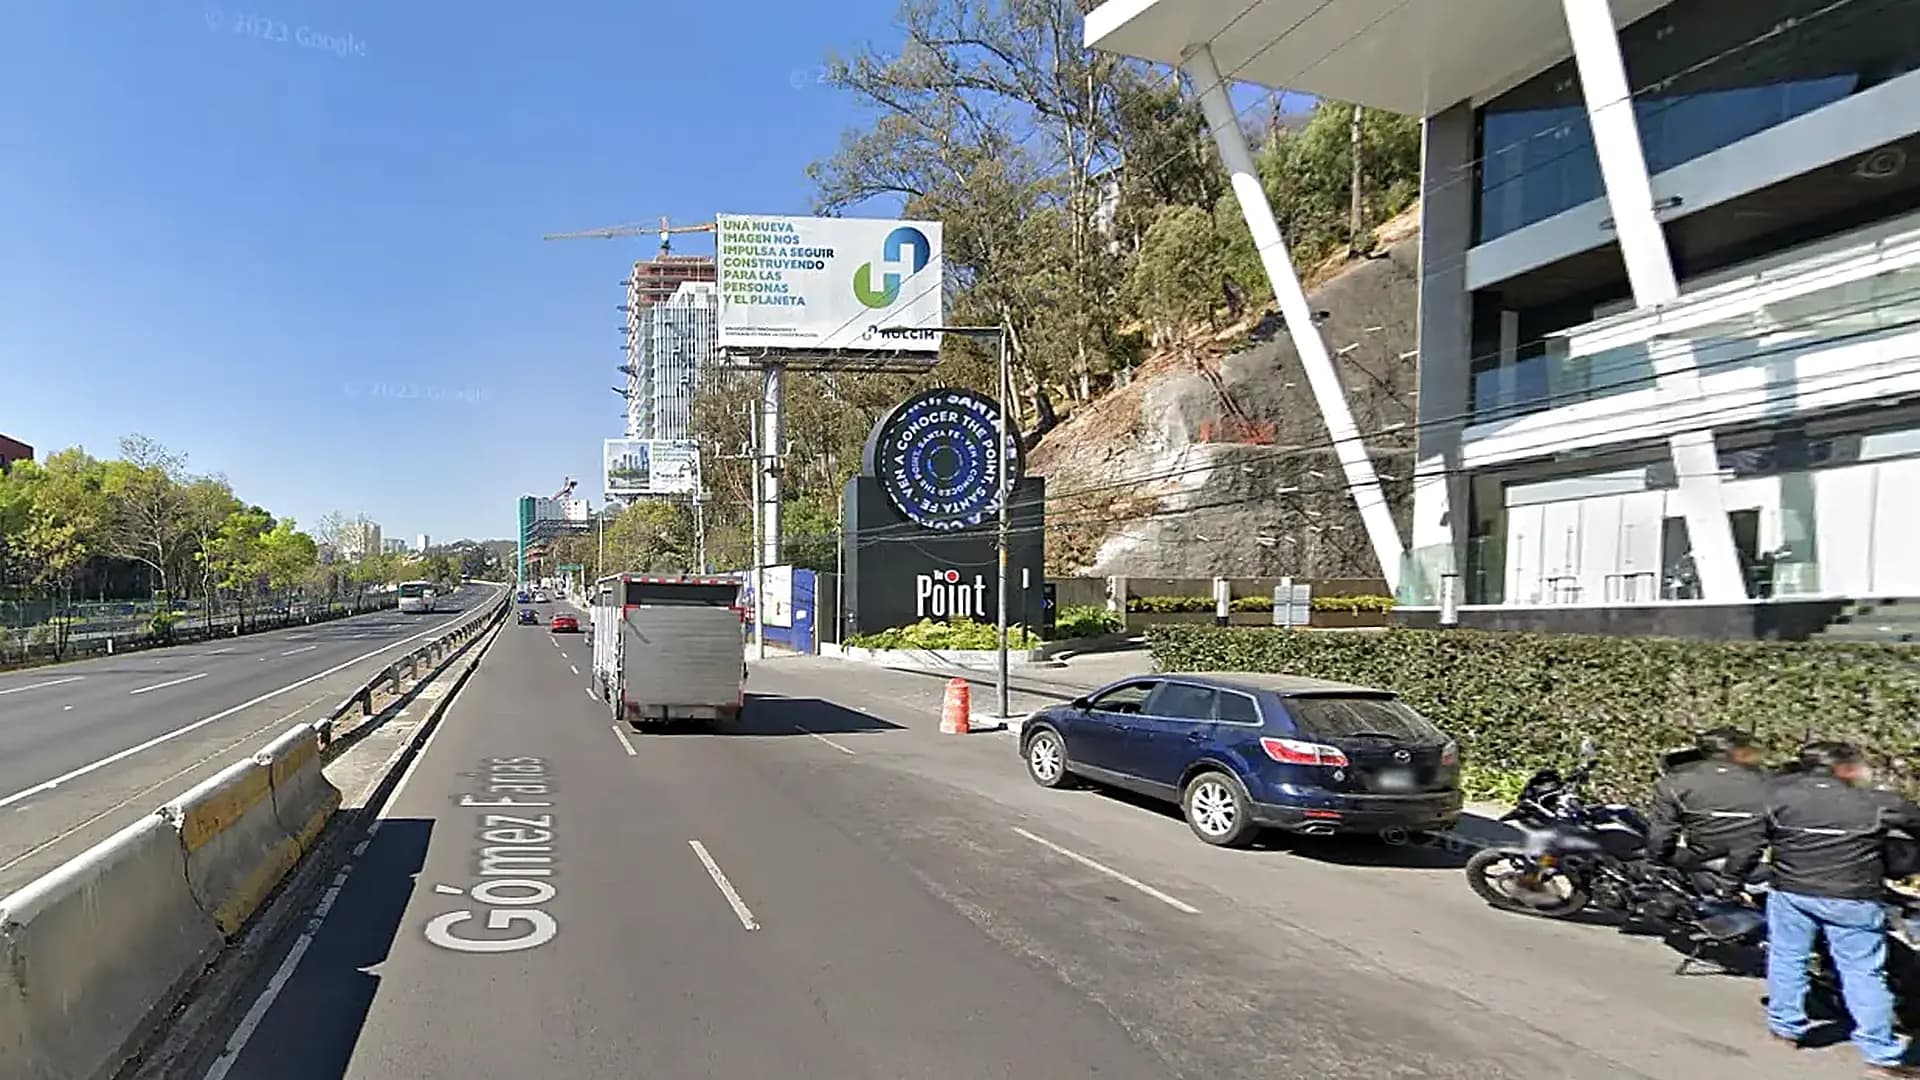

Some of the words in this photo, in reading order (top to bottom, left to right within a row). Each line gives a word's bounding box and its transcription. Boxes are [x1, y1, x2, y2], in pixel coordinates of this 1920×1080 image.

[723, 220, 750, 231] UNA
[752, 222, 794, 233] NUEVA
[723, 233, 772, 244] IMAGEN
[774, 235, 800, 244] NOS
[723, 246, 777, 256] IMPULSA
[780, 247, 788, 257] A
[790, 247, 835, 258] SEGUIR
[723, 258, 825, 270] CONSTRUYENDO
[723, 270, 757, 280] PARA
[760, 271, 782, 281] LAS
[723, 282, 789, 293] PERSONAS
[723, 294, 732, 304] Y
[735, 295, 748, 304] EL
[751, 295, 806, 306] PLANETA
[897, 411, 958, 451] CONOCER
[963, 414, 988, 439] THE
[918, 430, 946, 449] SANTA
[948, 429, 960, 439] FE
[965, 440, 977, 458] VEN
[894, 454, 905, 465] A
[980, 439, 998, 484] POINT,
[894, 468, 913, 498] VEN
[920, 498, 939, 513] FE
[942, 486, 986, 513] SANTA
[917, 569, 986, 617] Point
